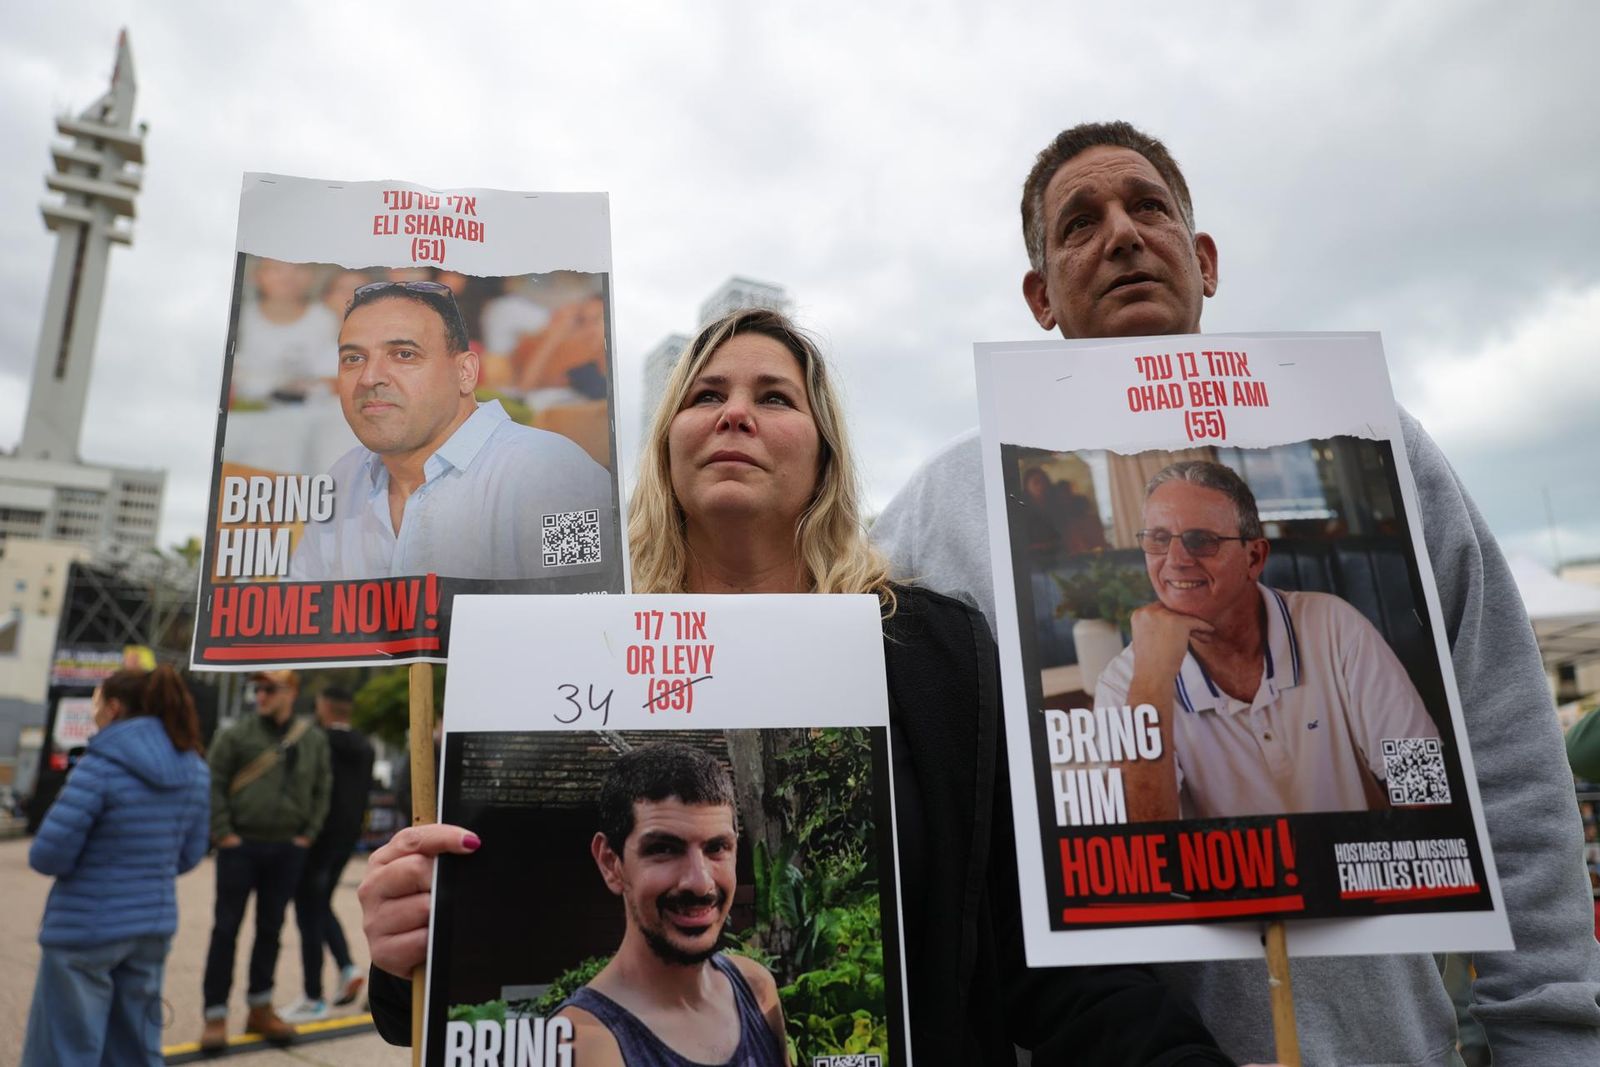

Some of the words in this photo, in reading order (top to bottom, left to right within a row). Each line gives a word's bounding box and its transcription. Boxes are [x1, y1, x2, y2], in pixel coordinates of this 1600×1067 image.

[383, 190, 440, 210] שרעבי
[446, 195, 477, 216] אלי
[373, 215, 399, 235] ELI
[404, 214, 485, 243] SHARABI
[411, 237, 446, 264] (51)
[1134, 354, 1173, 381] עמי
[1176, 352, 1200, 381] בן
[1201, 351, 1251, 377] אוהד
[1127, 383, 1184, 413] OHAD
[1187, 380, 1228, 407] BEN
[1233, 381, 1269, 407] AMI
[1184, 409, 1227, 441] (55)
[220, 474, 335, 524] BRING
[215, 528, 290, 577] HIM
[210, 584, 321, 637] HOME
[331, 572, 439, 634] NOW!
[634, 609, 664, 640] לוי
[670, 611, 707, 640] אור
[626, 645, 655, 675] OR
[662, 645, 714, 674] LEVY
[553, 684, 613, 726] 34
[648, 677, 693, 714] (33)
[1044, 703, 1163, 765] BRING
[1054, 767, 1128, 827] HIM
[1059, 833, 1172, 897] HOME
[1180, 819, 1299, 892] NOW!
[1334, 841, 1391, 863] HOSTAGES
[1392, 840, 1416, 861] AND
[1415, 838, 1468, 860] MISSING
[1338, 861, 1413, 892] FAMILIES
[1412, 858, 1475, 889] FORUM
[444, 1016, 575, 1067] BRING
